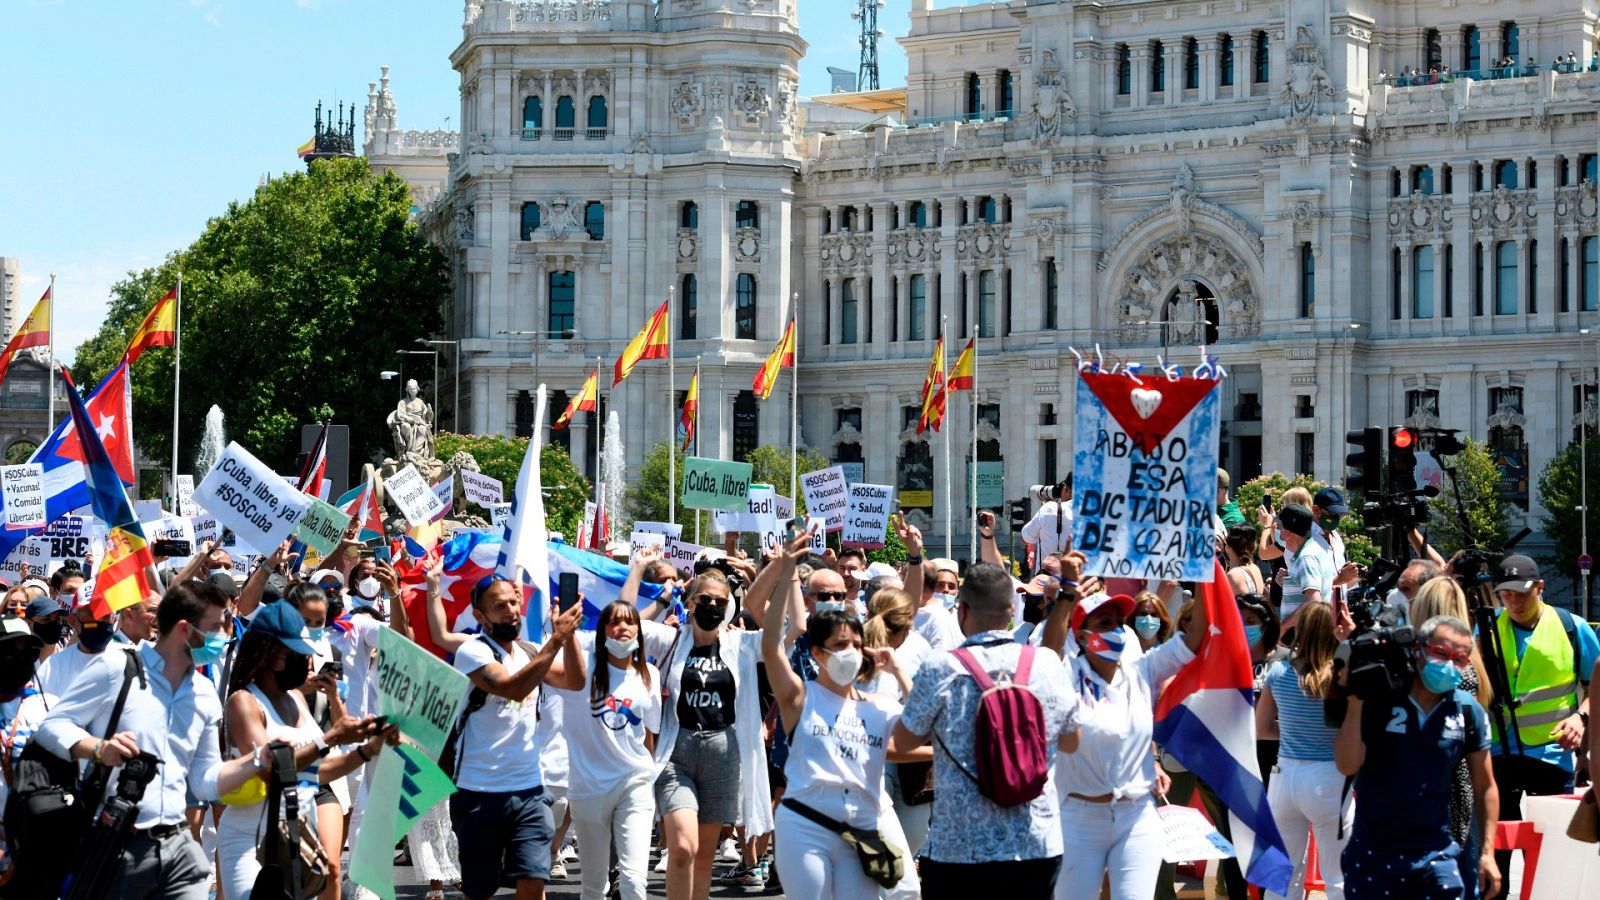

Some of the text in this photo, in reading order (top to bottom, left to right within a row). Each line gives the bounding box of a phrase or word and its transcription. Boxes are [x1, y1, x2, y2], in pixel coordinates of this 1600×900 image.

[1092, 429, 1187, 463] ABAJO
[216, 457, 301, 524] ¡Cuba, libre, ya!
[684, 469, 750, 498] ¡Cuba, libre!
[1127, 463, 1189, 493] ESA
[215, 482, 273, 533] #SOSCuba
[858, 503, 885, 515] Salud,
[1080, 489, 1214, 529] DICTADURA
[318, 517, 344, 544] libre!
[1081, 522, 1214, 559] DE 62 AÑOS
[1102, 557, 1184, 579] NO MÁS
[405, 682, 421, 717] y
[420, 680, 458, 735] Vida!
[1385, 706, 1408, 734] 2
